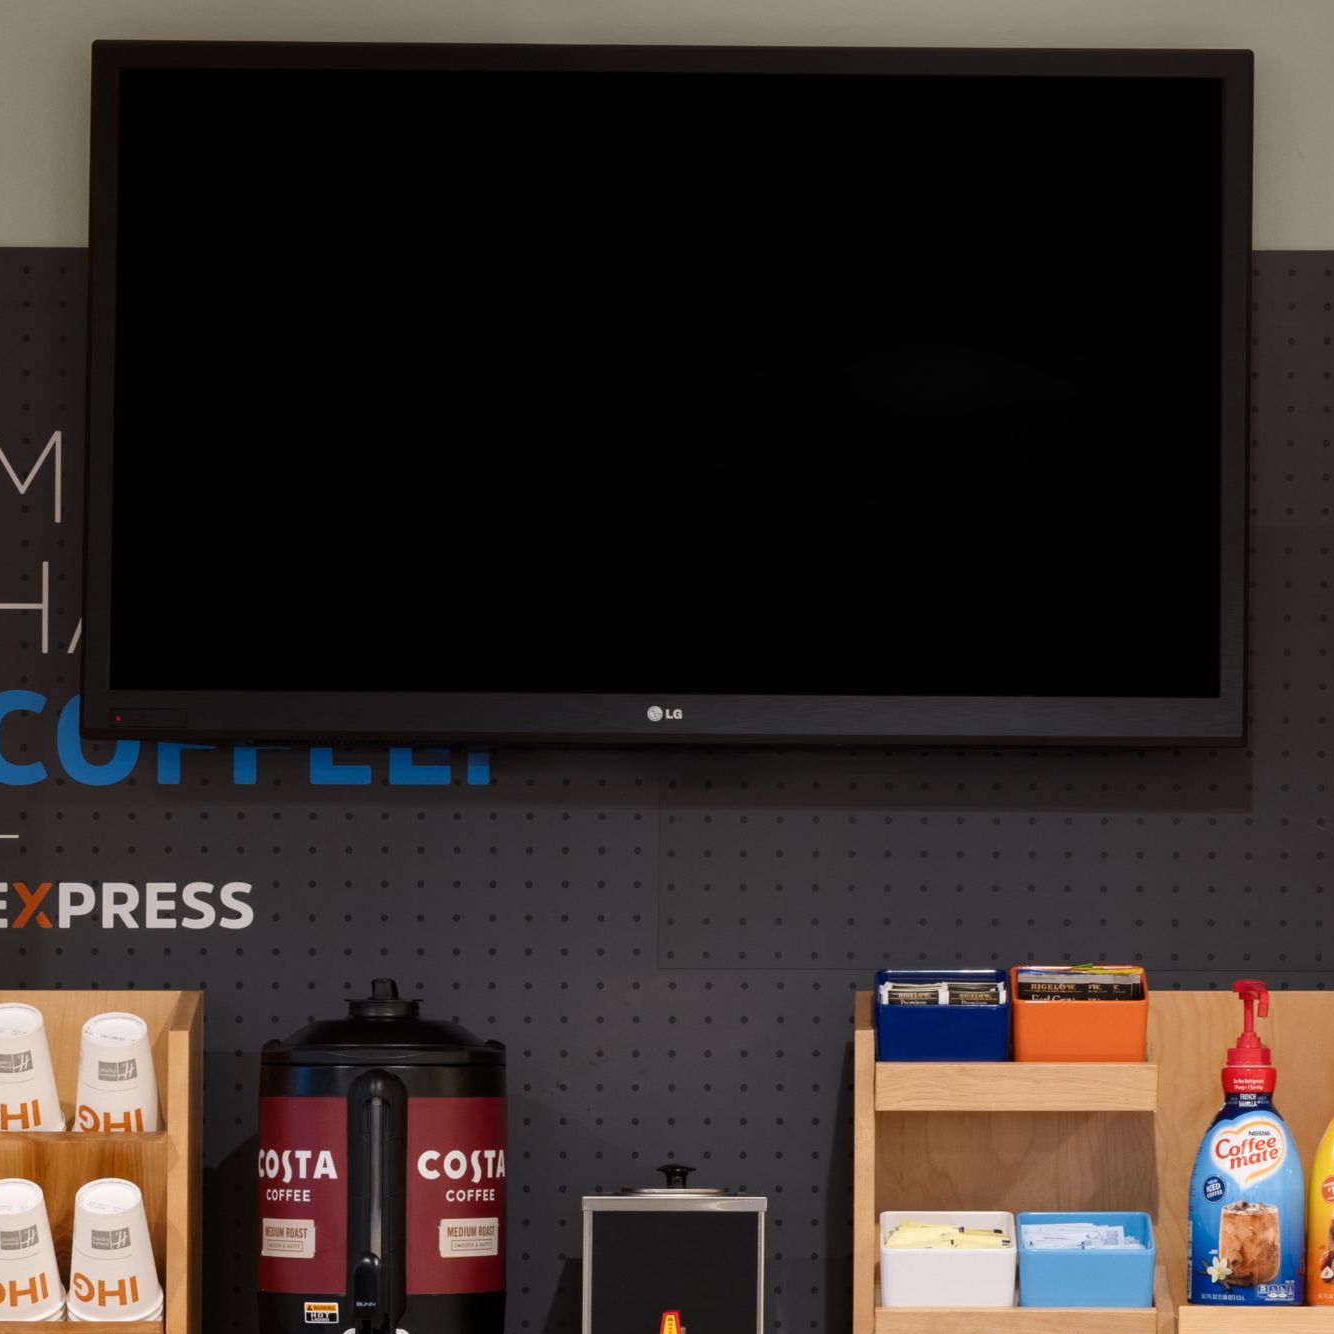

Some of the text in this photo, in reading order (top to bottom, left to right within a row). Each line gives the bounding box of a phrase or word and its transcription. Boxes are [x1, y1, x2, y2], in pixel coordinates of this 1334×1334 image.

[665, 708, 683, 720] LG
[77, 1104, 145, 1132] IHG
[1215, 1137, 1277, 1159] Coffee
[258, 1149, 338, 1183] COSTA
[417, 1149, 506, 1184] COSTA
[1230, 1148, 1279, 1170] mate
[266, 1188, 311, 1202] COFFEE
[446, 1188, 495, 1202] COFFEE
[265, 1226, 308, 1239] MEDIUM ROAST
[447, 1225, 495, 1238] MEDIUM ROAST
[73, 1272, 140, 1307] IHG
[312, 1304, 336, 1312] WARNING
